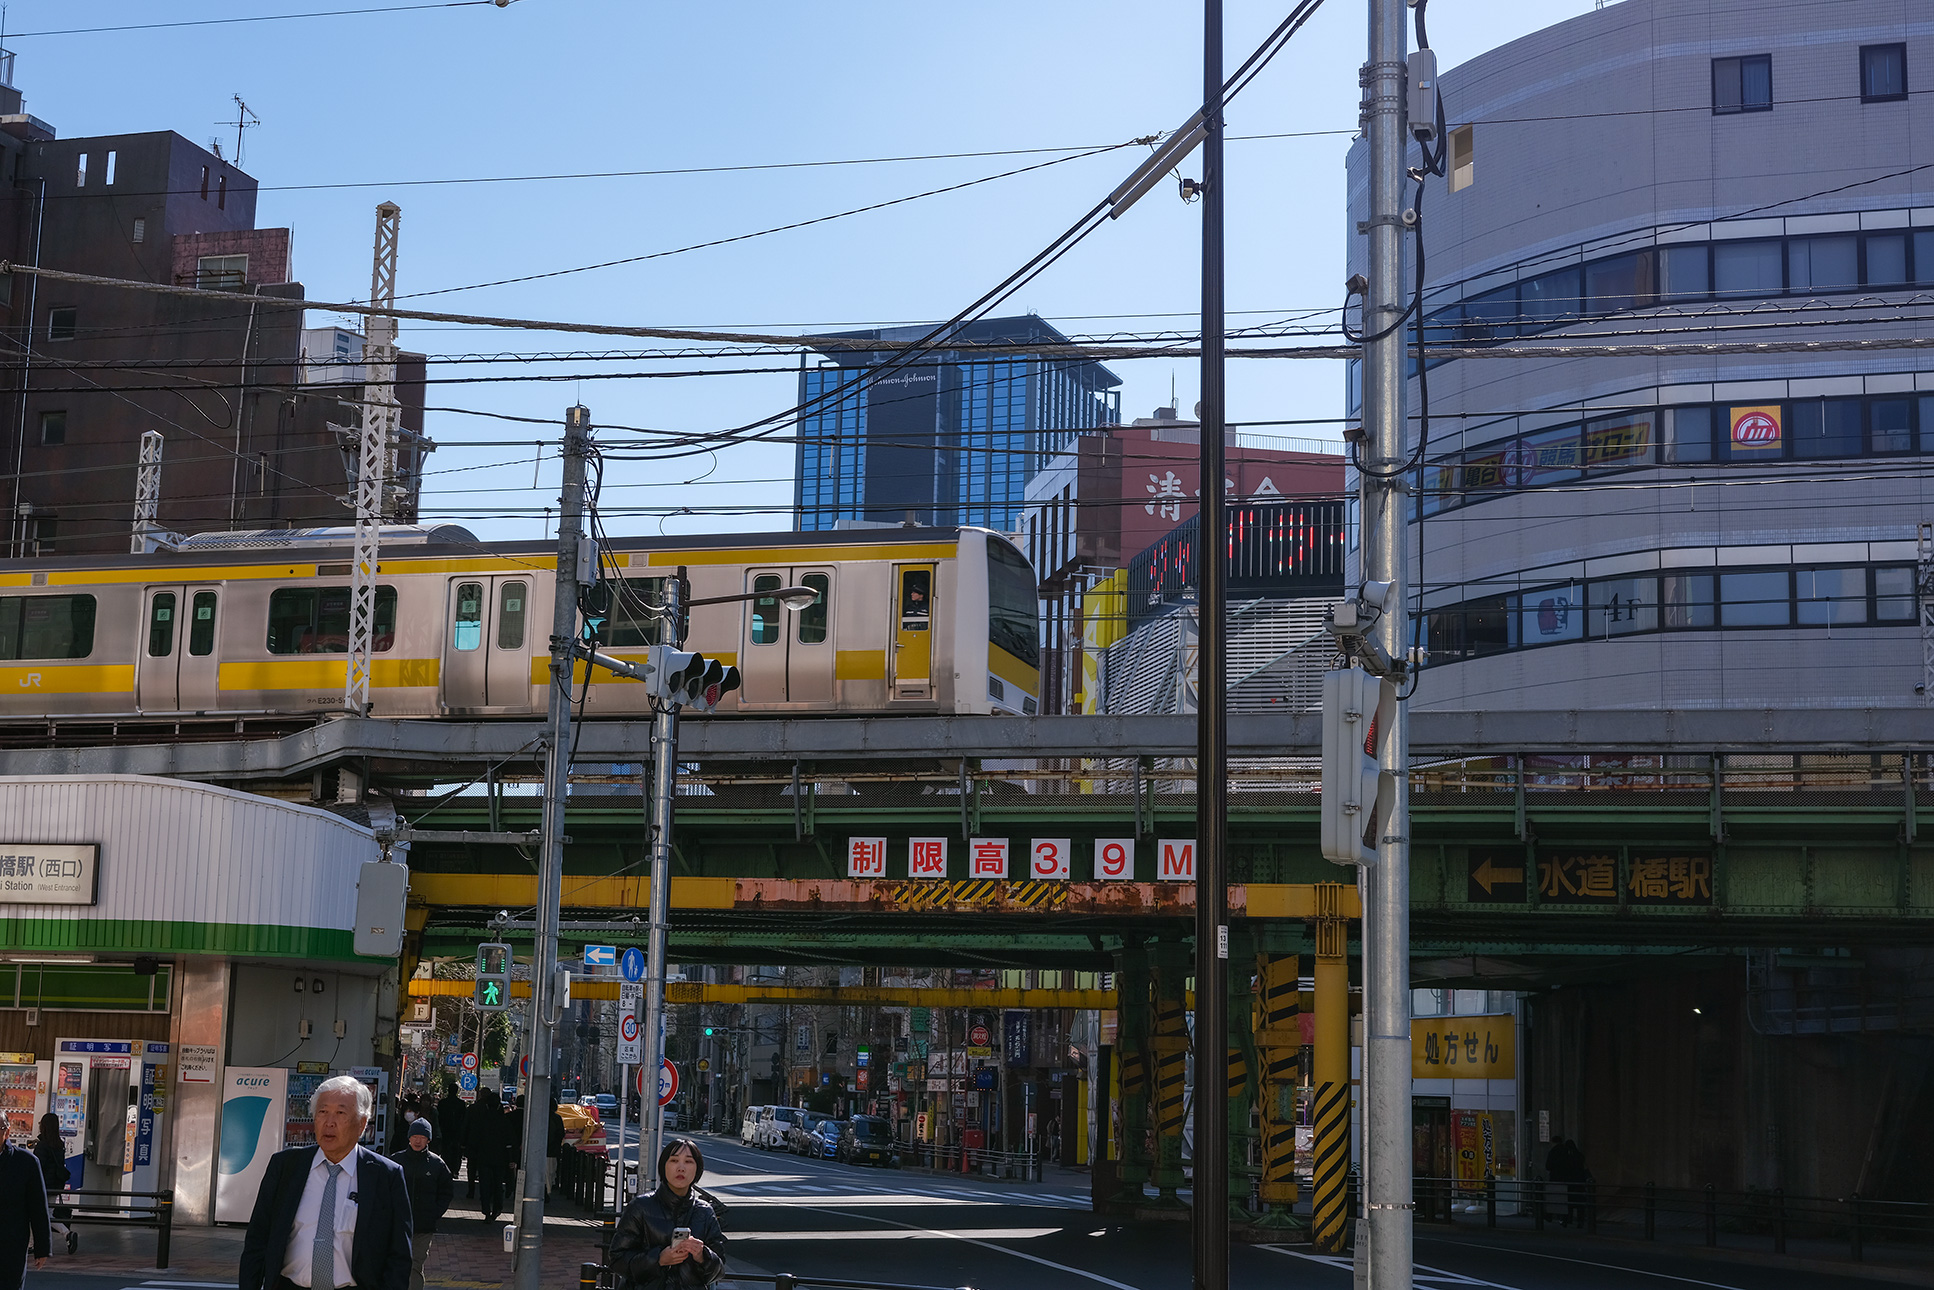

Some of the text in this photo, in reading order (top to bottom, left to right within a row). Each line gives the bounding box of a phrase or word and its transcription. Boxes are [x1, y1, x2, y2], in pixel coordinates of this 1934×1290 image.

[19, 672, 42, 688] JR
[1539, 855, 1711, 899] 水道橋駅
[5, 880, 33, 891] Station
[38, 884, 53, 892] (West
[54, 884, 81, 893] Entrance)
[625, 1022, 636, 1034] 30
[69, 1042, 129, 1053] 証明写真
[1425, 1030, 1499, 1065] 処方せん
[465, 1057, 475, 1066] 40
[236, 1076, 270, 1087] acure
[138, 1067, 156, 1162] 証明写真
